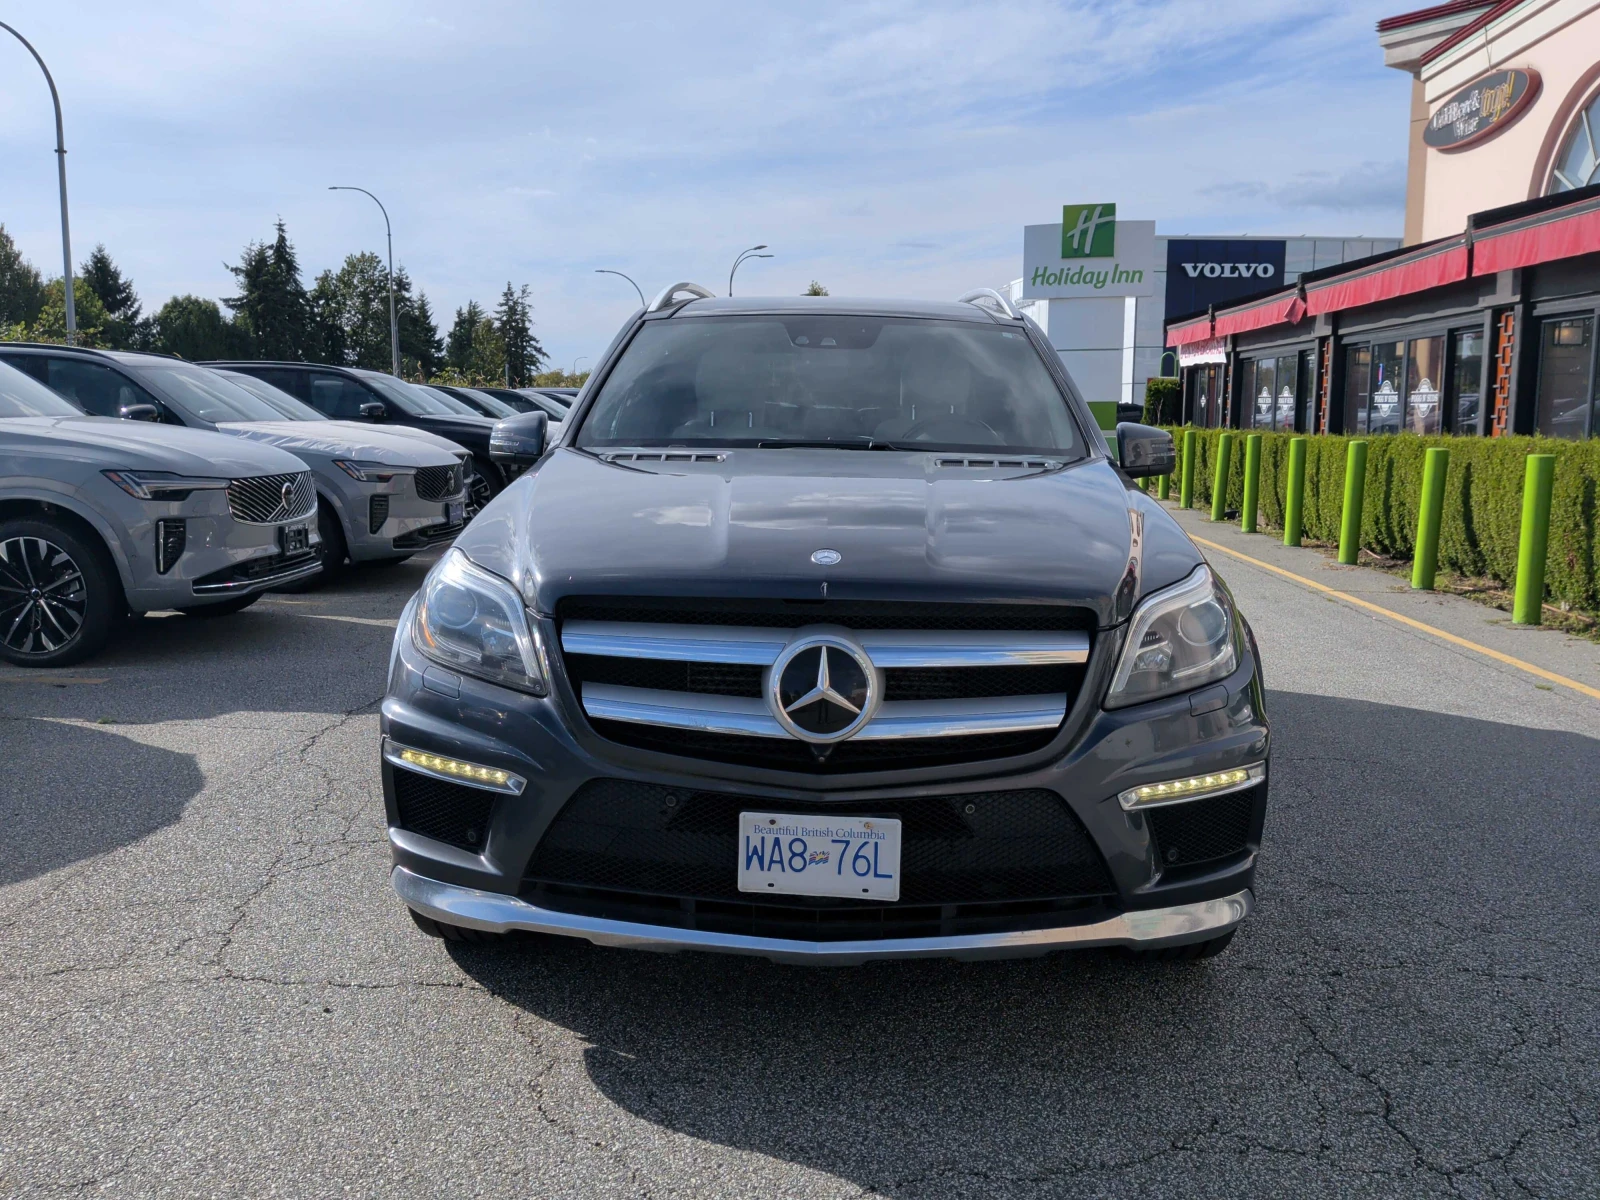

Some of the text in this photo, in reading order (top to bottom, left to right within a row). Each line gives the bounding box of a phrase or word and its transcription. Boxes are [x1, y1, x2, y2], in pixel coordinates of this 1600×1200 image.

[1031, 264, 1144, 289] Holiday Inn
[1181, 262, 1275, 278] VOLVO
[753, 824, 886, 840] Beautiful British Columbia
[745, 835, 893, 879] WA8 76L
